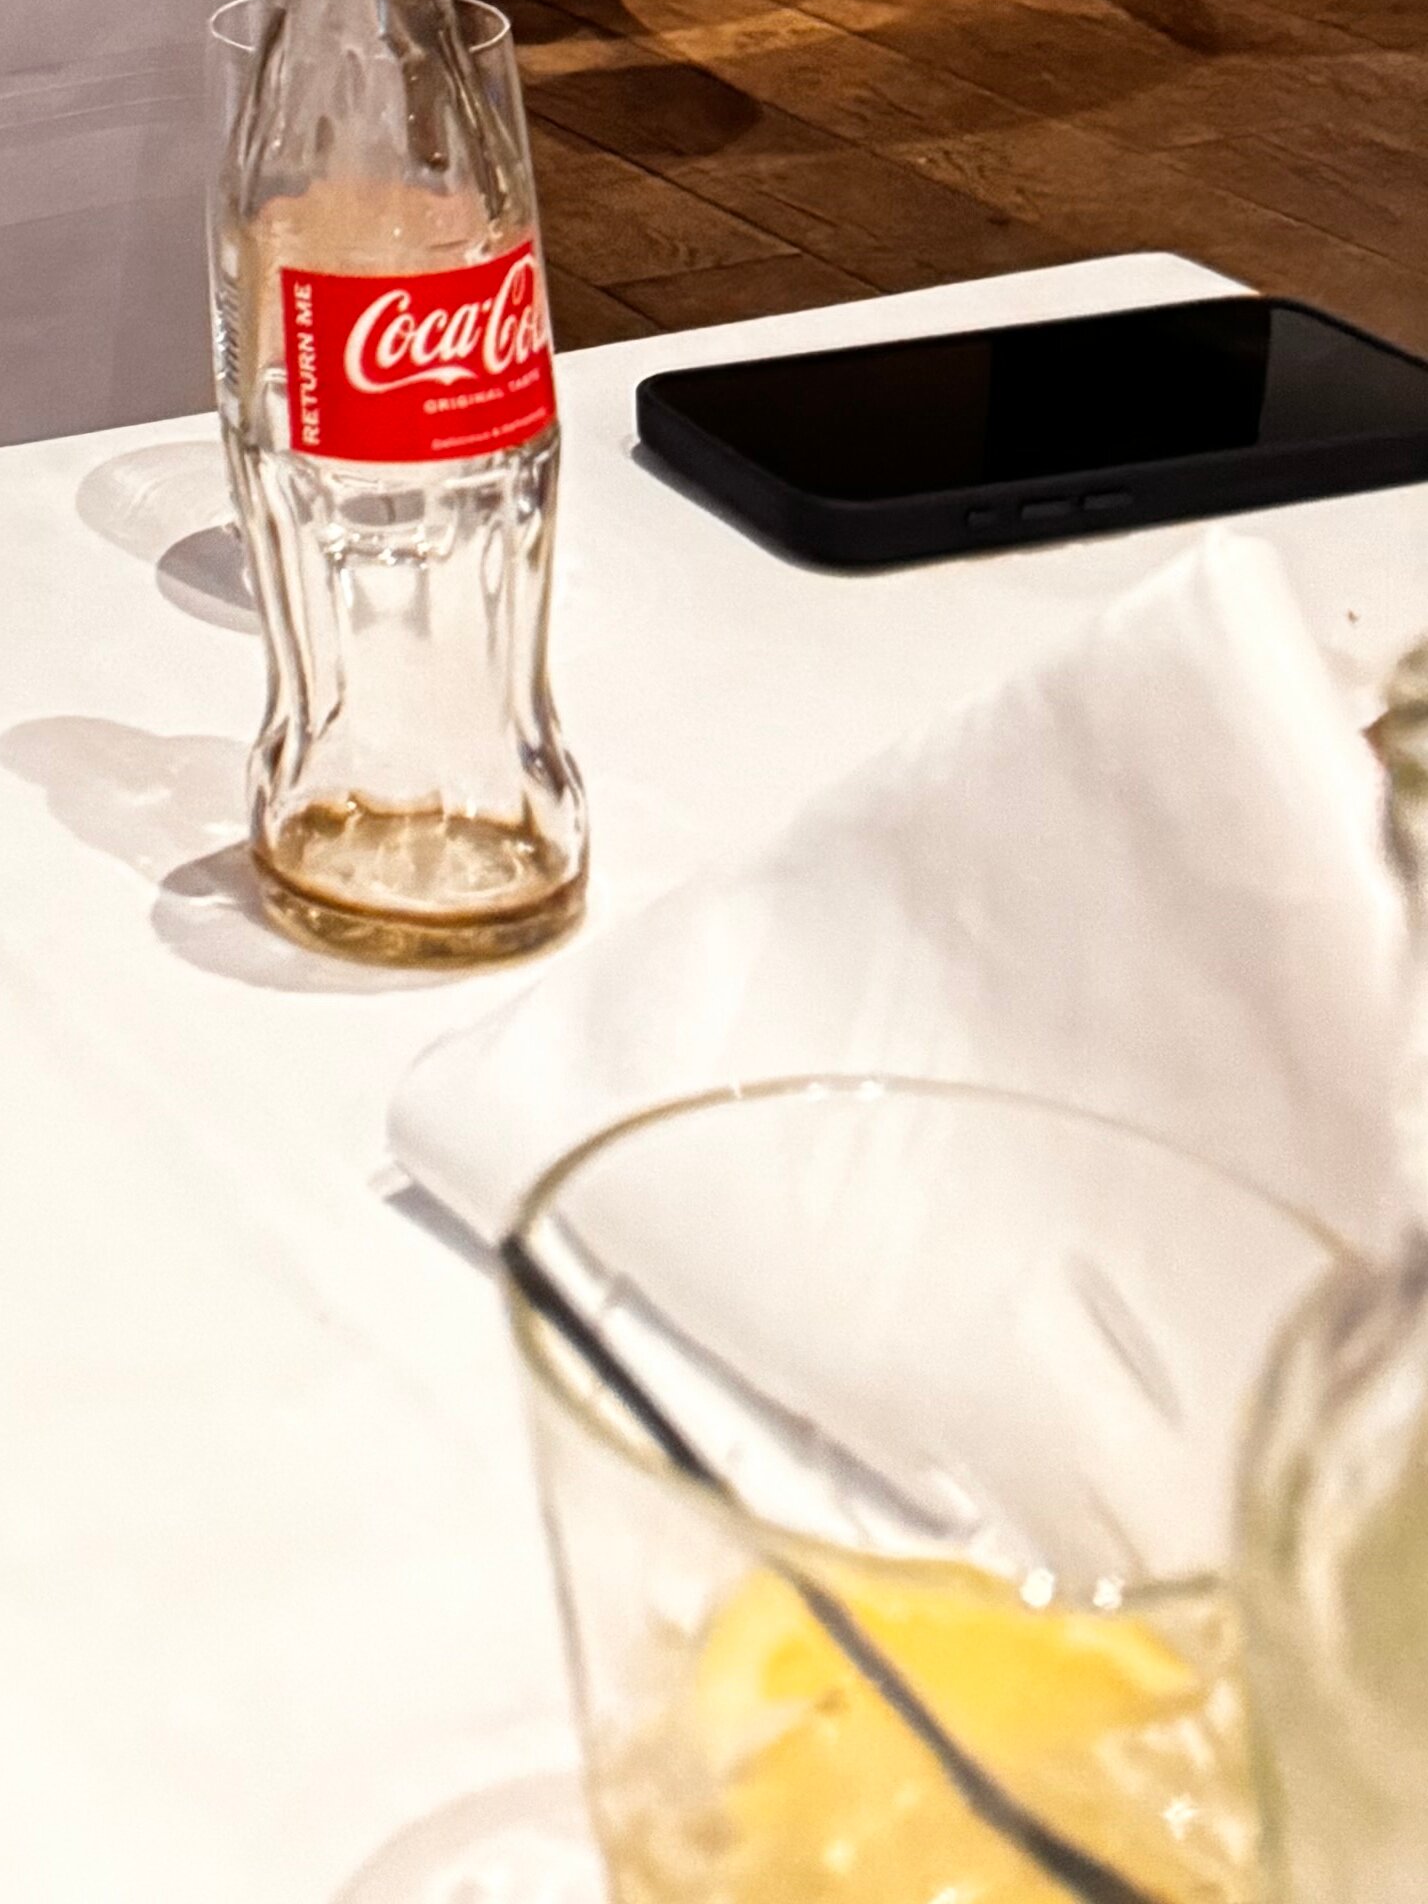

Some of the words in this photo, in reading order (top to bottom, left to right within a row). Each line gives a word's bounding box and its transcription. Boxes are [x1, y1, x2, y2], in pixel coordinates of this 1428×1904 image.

[294, 281, 313, 328] ME
[344, 252, 547, 394] Coca-Co
[296, 331, 321, 446] RETURN
[422, 386, 505, 415] ORIGINAL
